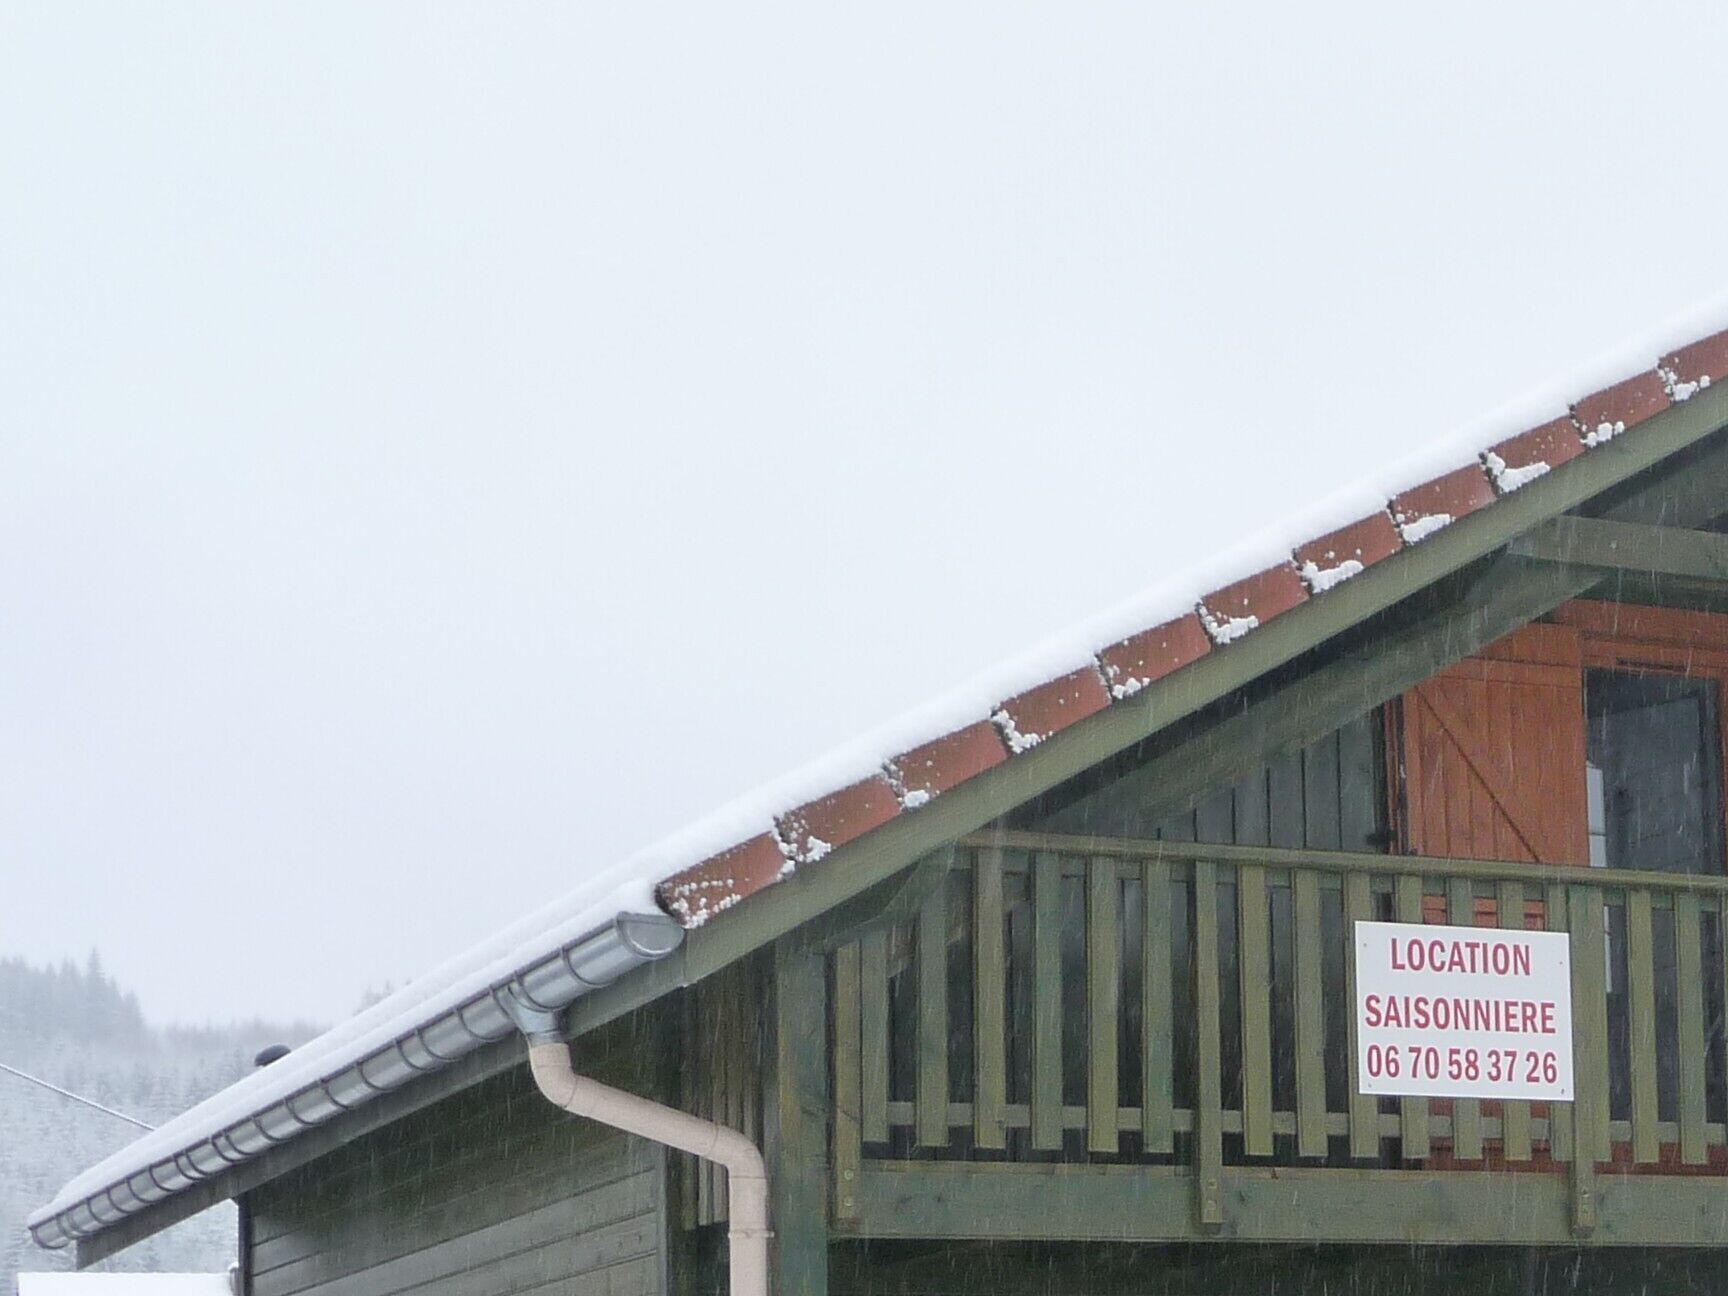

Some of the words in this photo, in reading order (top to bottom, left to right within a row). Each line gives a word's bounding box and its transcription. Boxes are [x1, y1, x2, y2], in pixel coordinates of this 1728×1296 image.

[1391, 938, 1530, 976] LOCATION
[1365, 994, 1556, 1034] SAISONNIERE
[1367, 1044, 1400, 1078] 06
[1408, 1046, 1440, 1080] 70
[1448, 1048, 1480, 1081] 58
[1487, 1049, 1518, 1082] 37
[1525, 1051, 1557, 1084] 26
